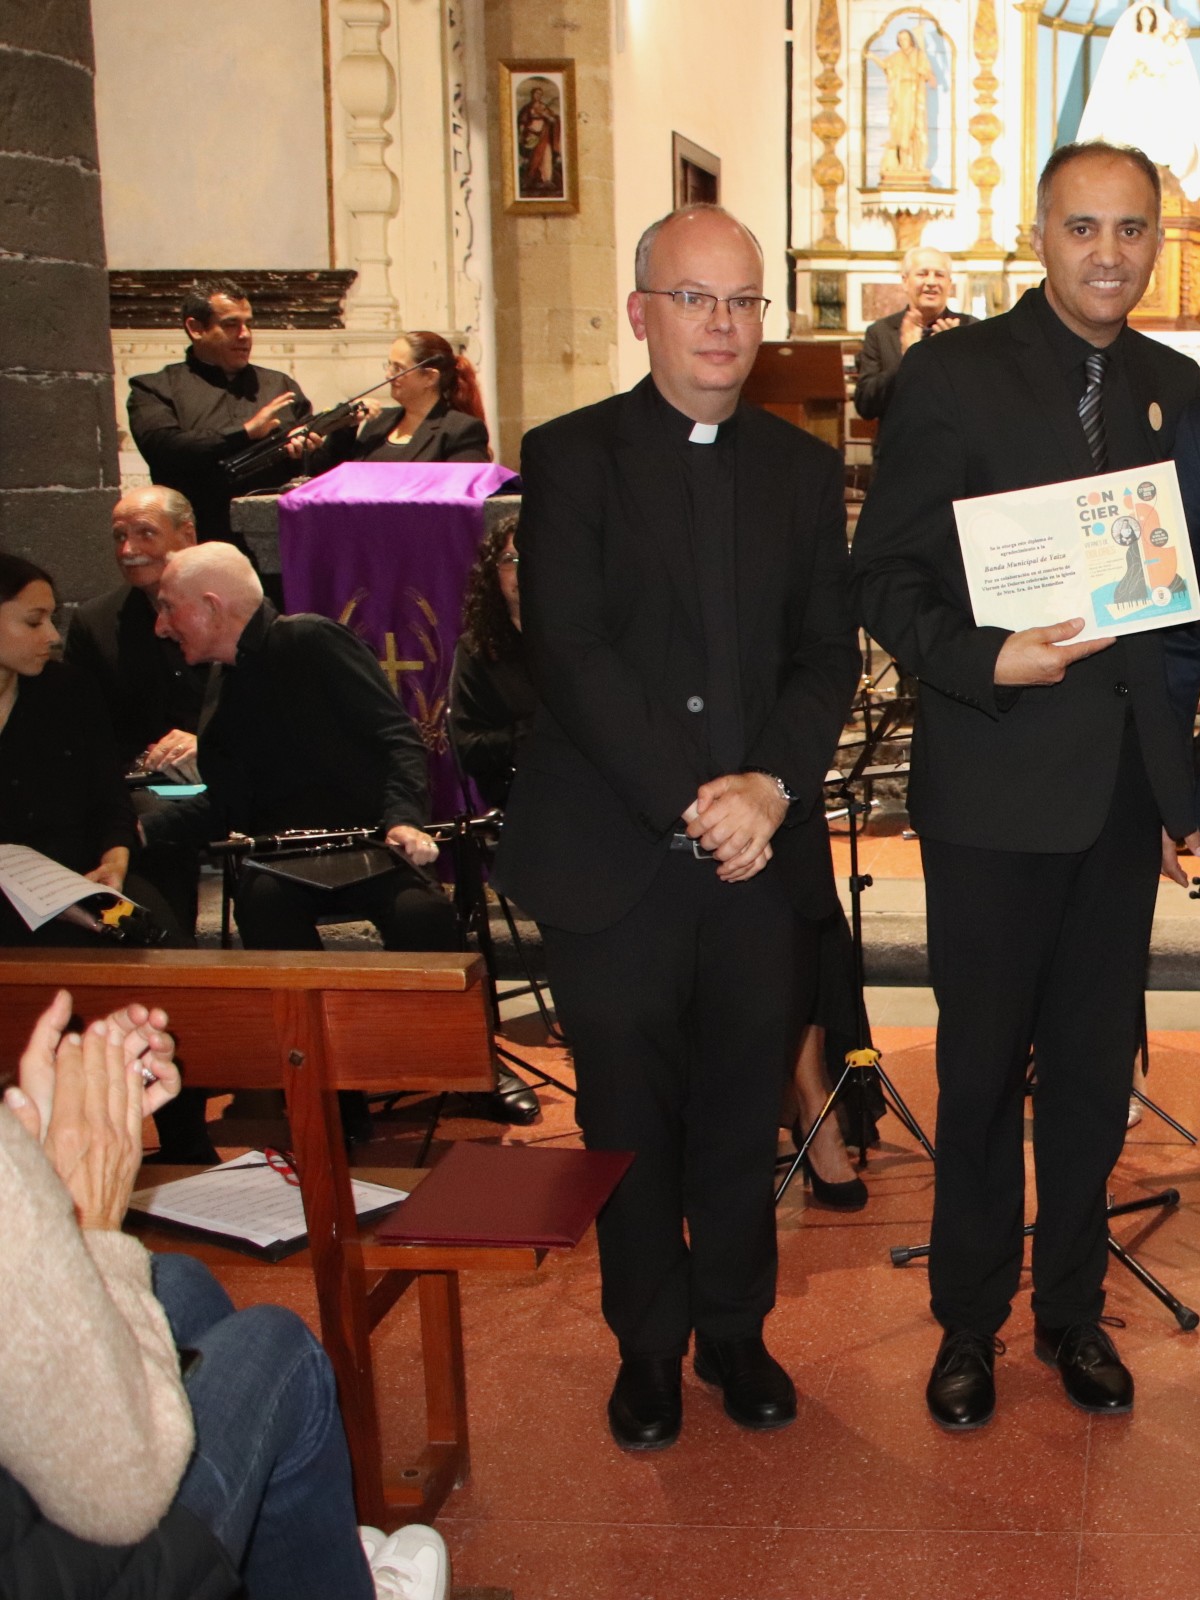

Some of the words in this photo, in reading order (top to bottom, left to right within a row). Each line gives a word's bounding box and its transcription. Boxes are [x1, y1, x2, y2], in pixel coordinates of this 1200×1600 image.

[1077, 490, 1114, 507] CON
[1079, 505, 1119, 522] CIER
[1081, 522, 1105, 537] TO
[985, 563, 1005, 573] Banda
[1007, 558, 1038, 569] Municipal
